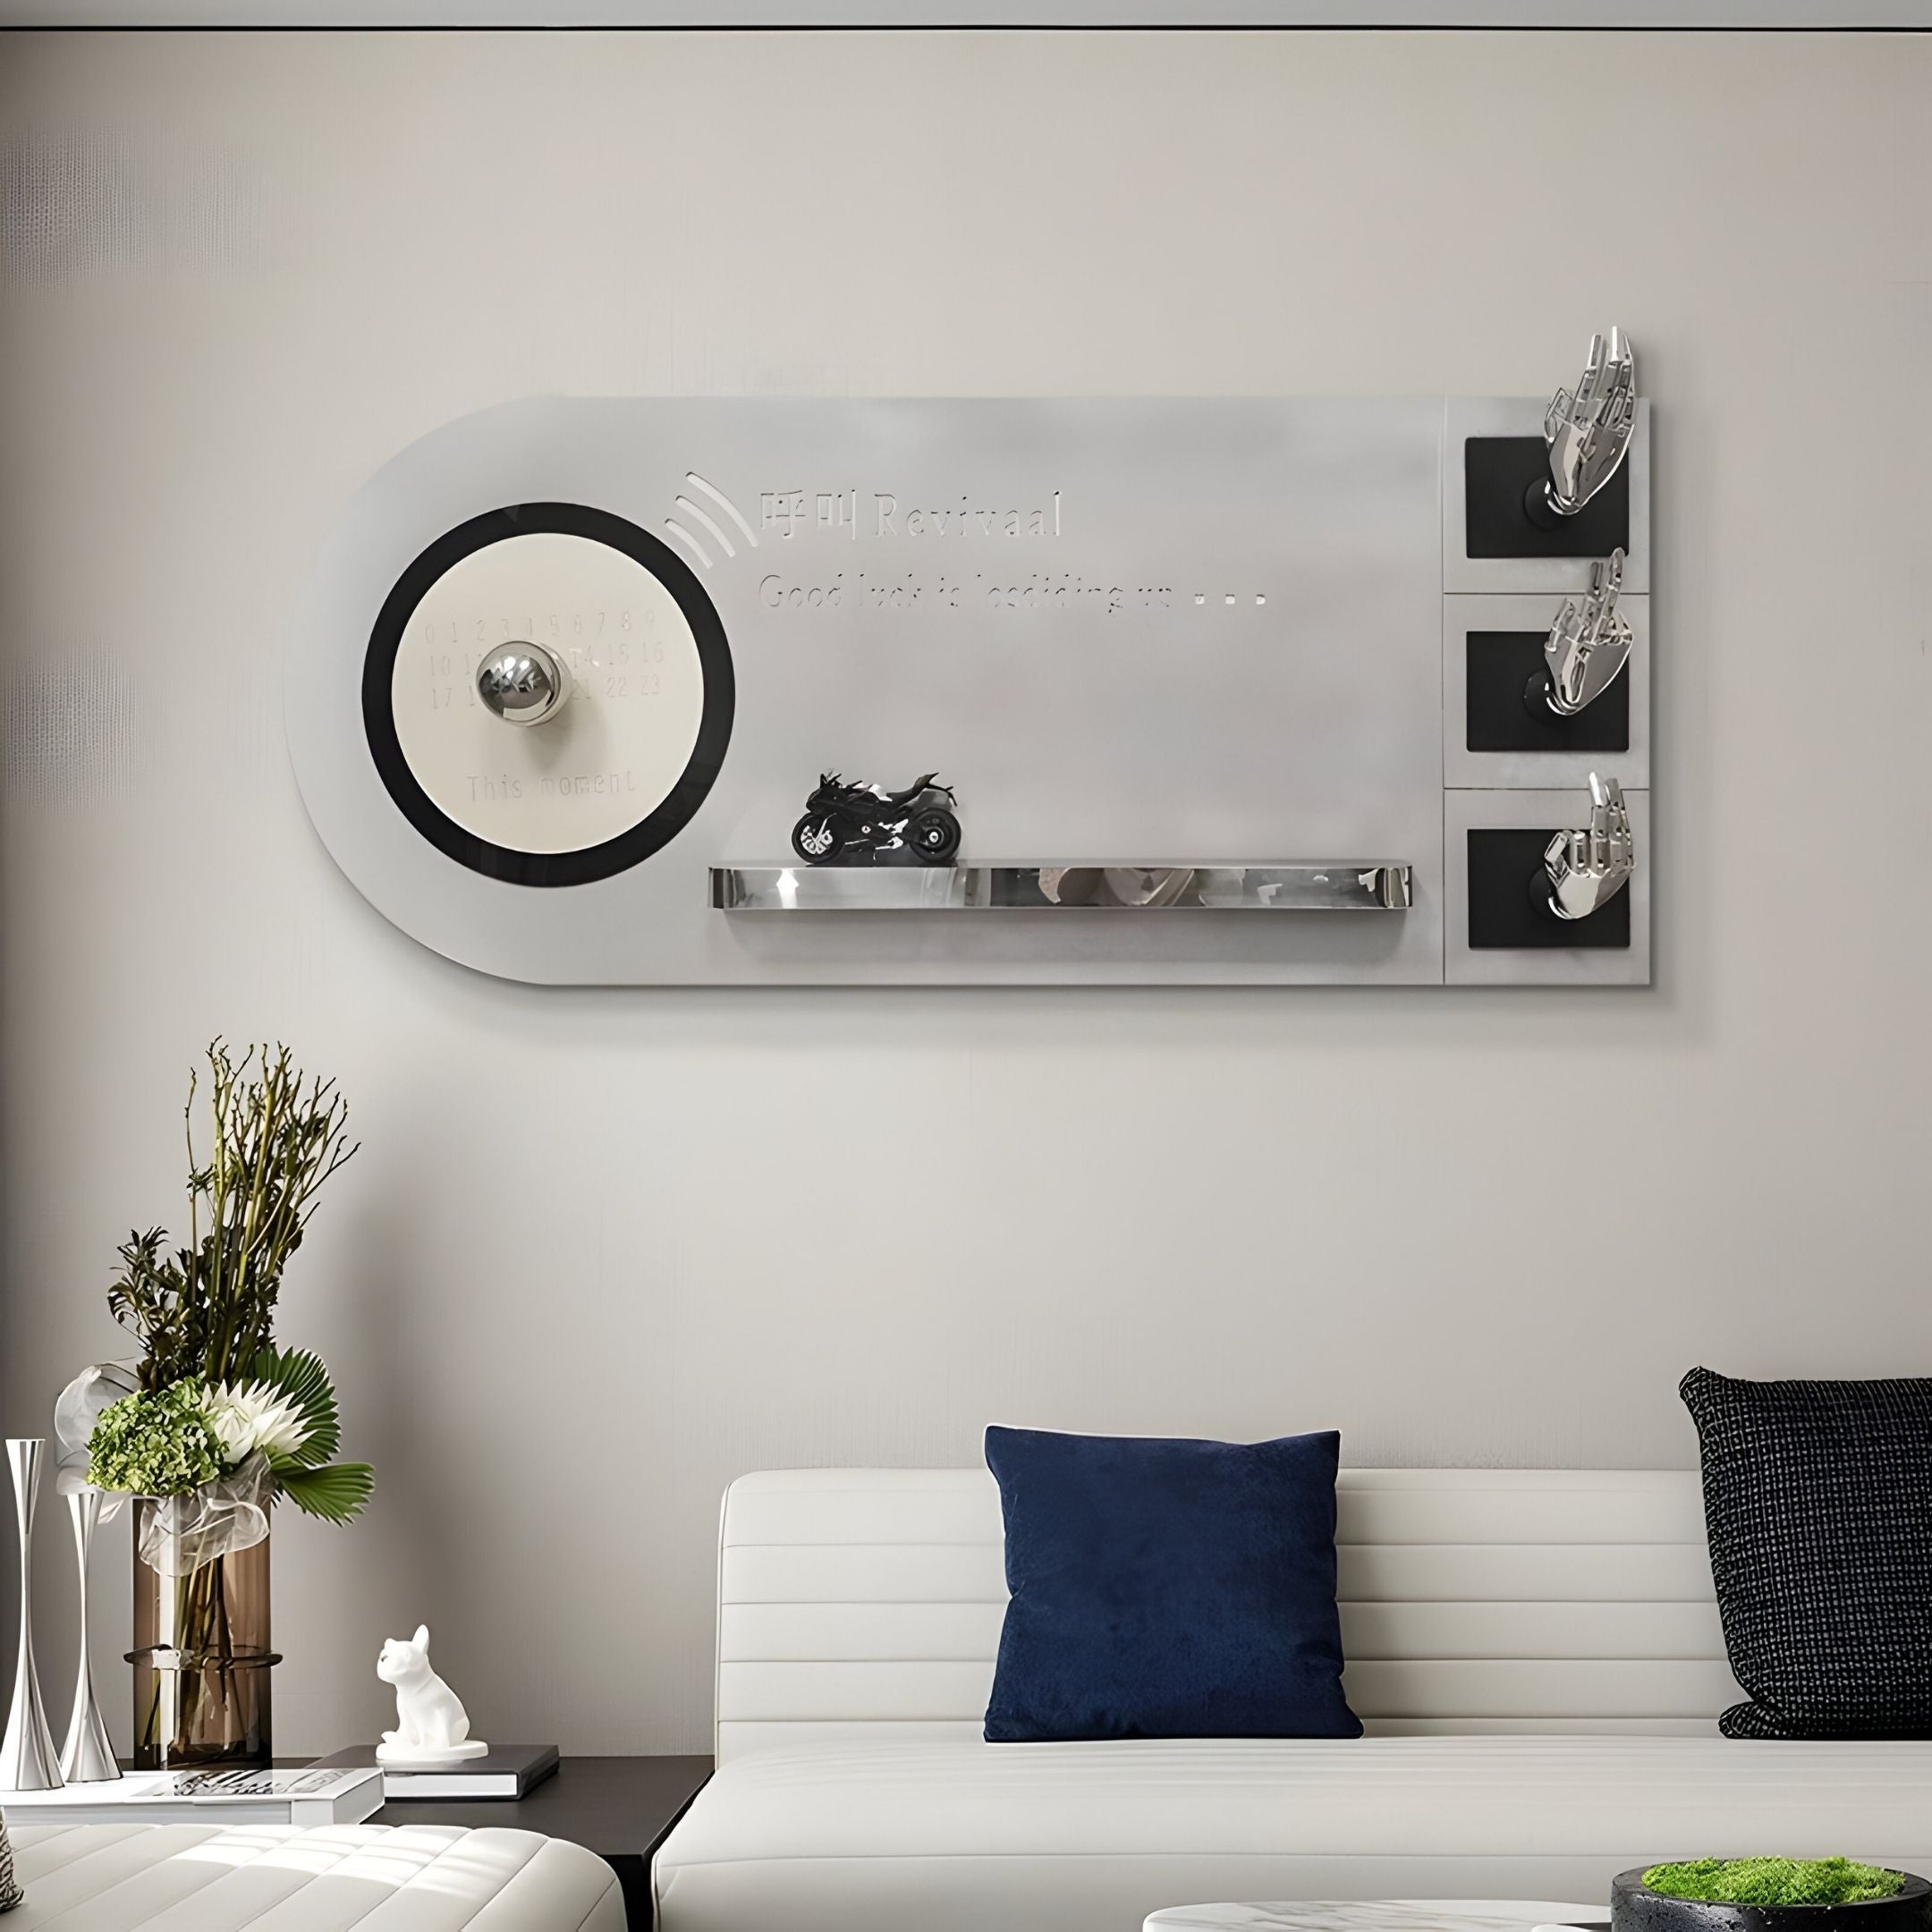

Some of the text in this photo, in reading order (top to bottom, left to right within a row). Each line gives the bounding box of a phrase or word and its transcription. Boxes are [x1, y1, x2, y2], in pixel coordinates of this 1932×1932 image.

[759, 488, 1063, 540] 呼叫 Revivaal
[758, 573, 843, 607] Good
[465, 773, 523, 802] This
